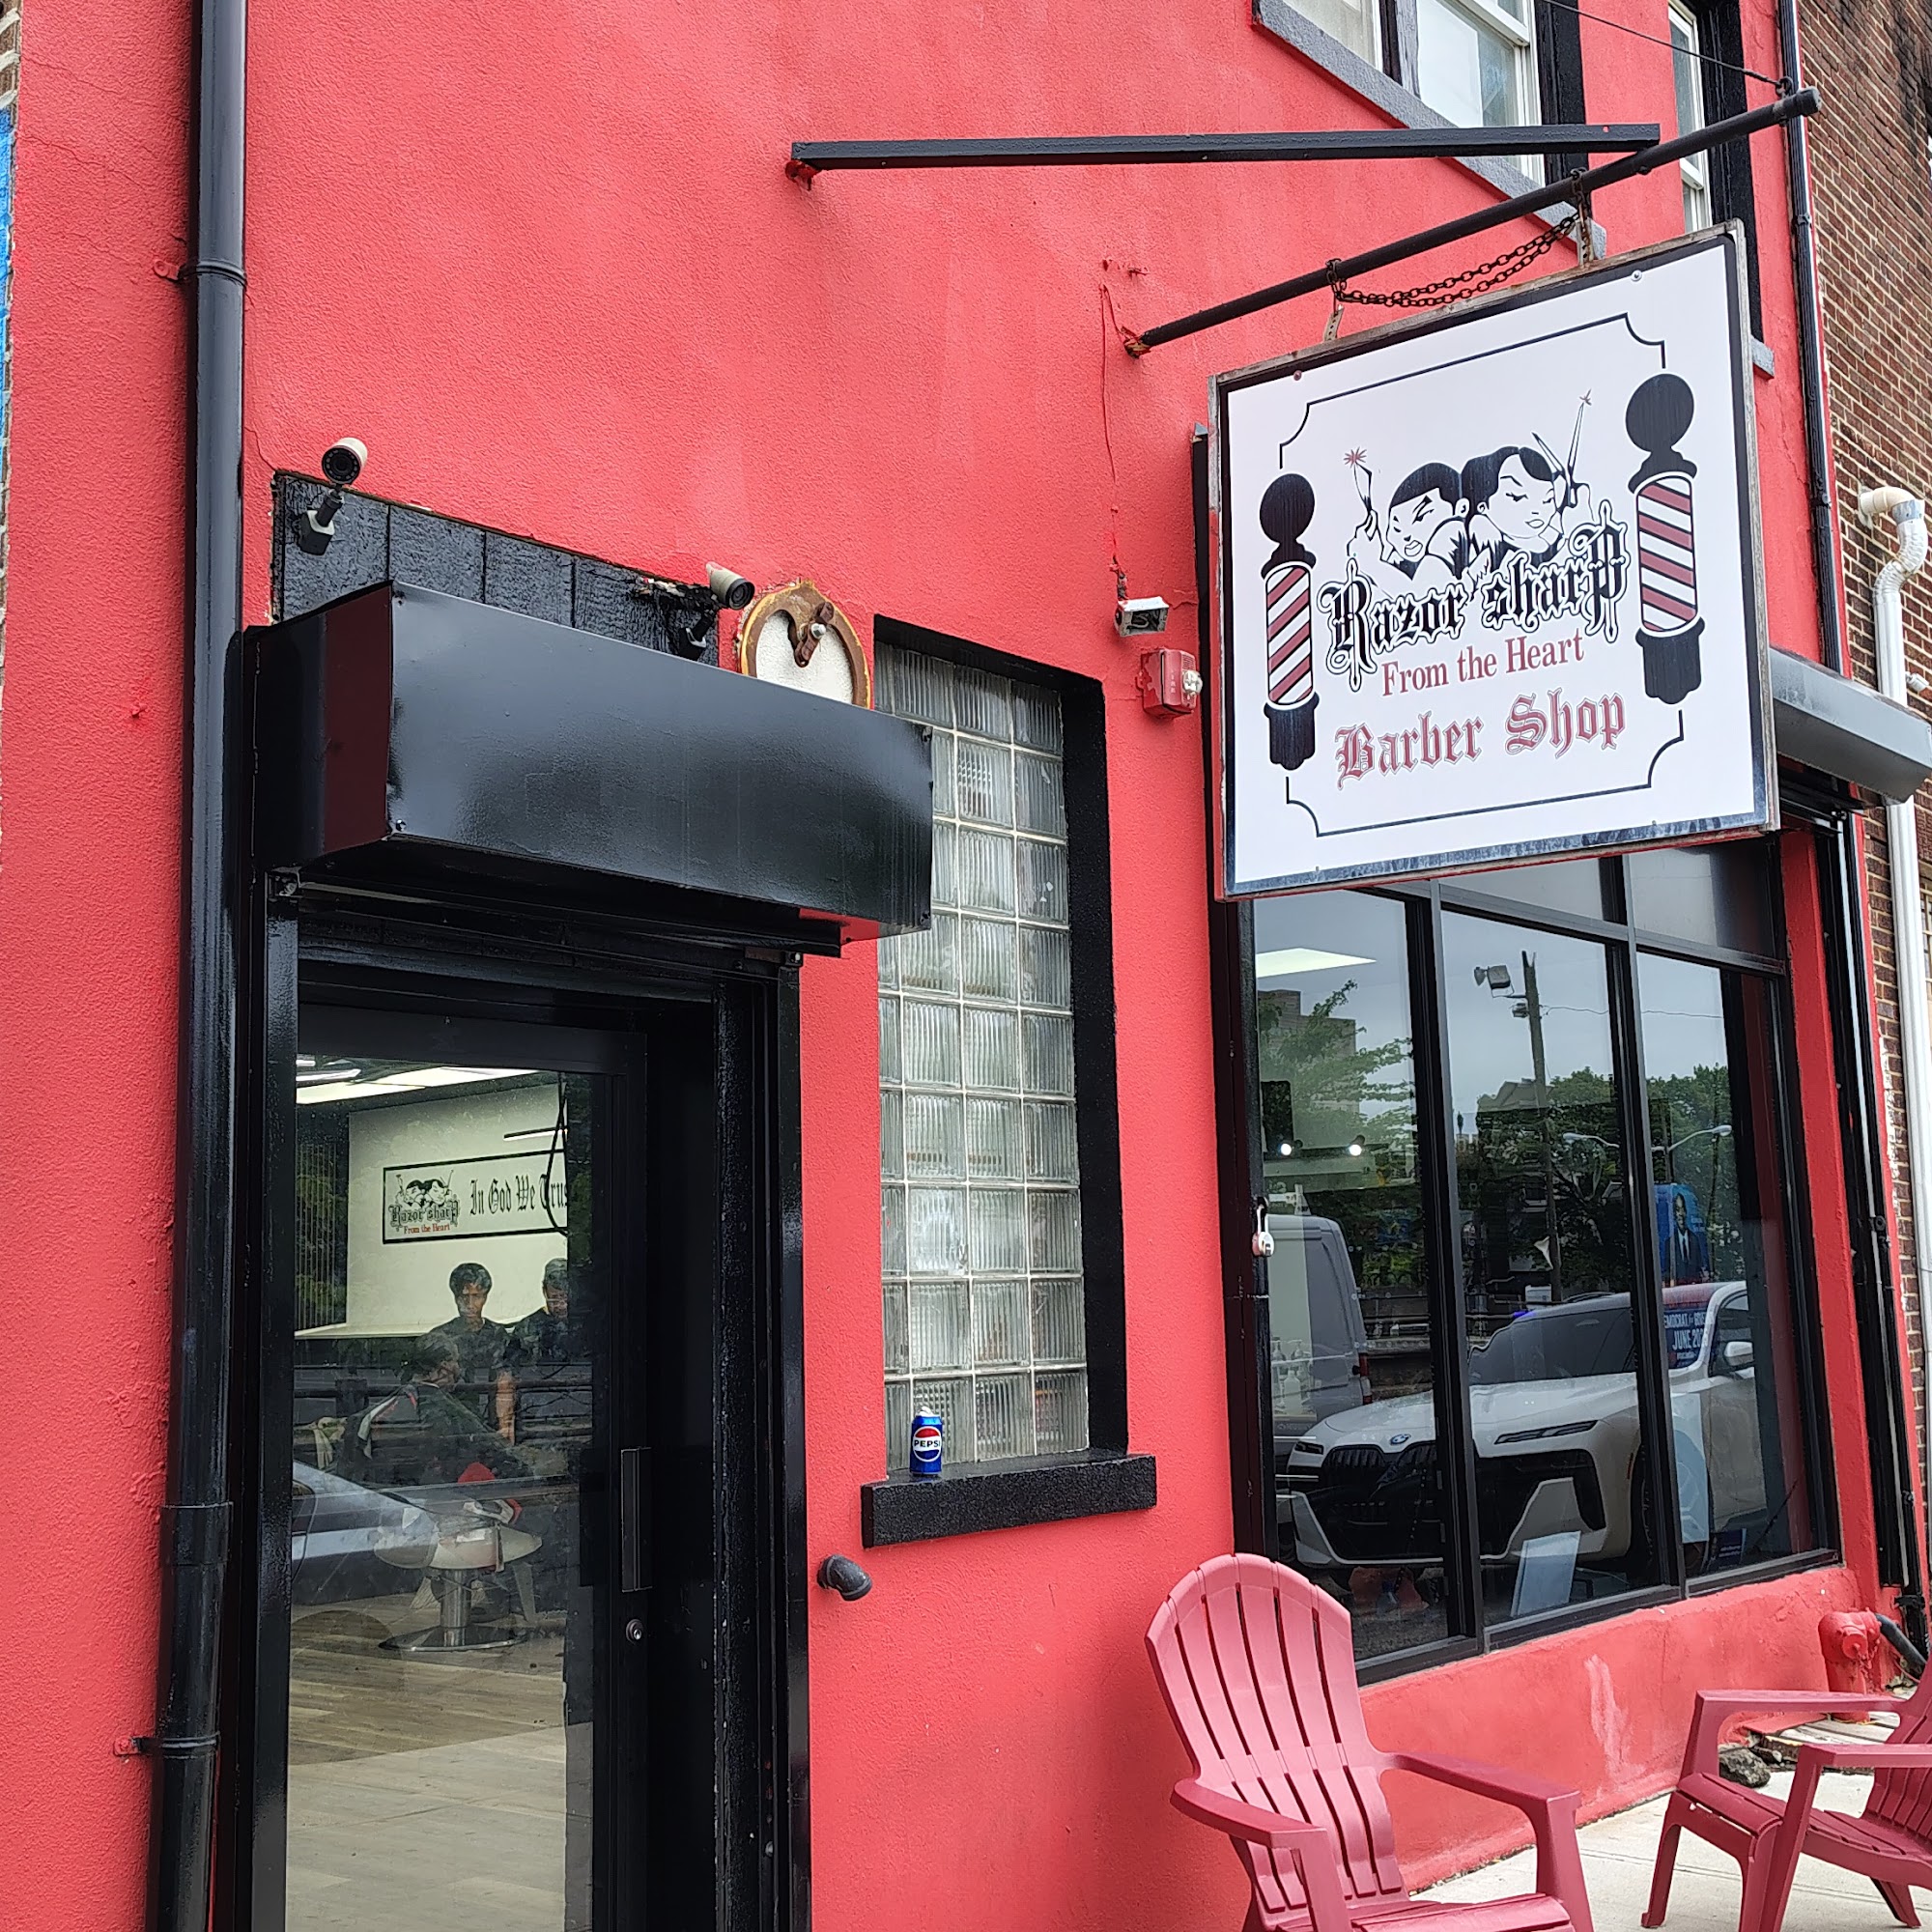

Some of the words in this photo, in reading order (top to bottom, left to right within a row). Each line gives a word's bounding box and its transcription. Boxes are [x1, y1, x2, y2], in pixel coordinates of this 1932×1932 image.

[1318, 558, 1467, 692] Razor
[1481, 499, 1631, 643] sharp
[1381, 661, 1449, 696] From
[1457, 645, 1497, 683] the
[1505, 628, 1584, 673] Heart
[1335, 711, 1484, 790] Barber
[1504, 687, 1626, 758] Shop
[388, 1199, 425, 1232] Razor
[427, 1195, 461, 1227] sharp
[470, 1179, 484, 1215] In
[489, 1179, 511, 1214] God
[515, 1174, 535, 1211] We
[404, 1225, 419, 1235] From
[421, 1224, 431, 1233] the
[432, 1223, 450, 1232] Heart
[1672, 1329, 1691, 1350] JUNE
[914, 1439, 941, 1448] PEPSI
